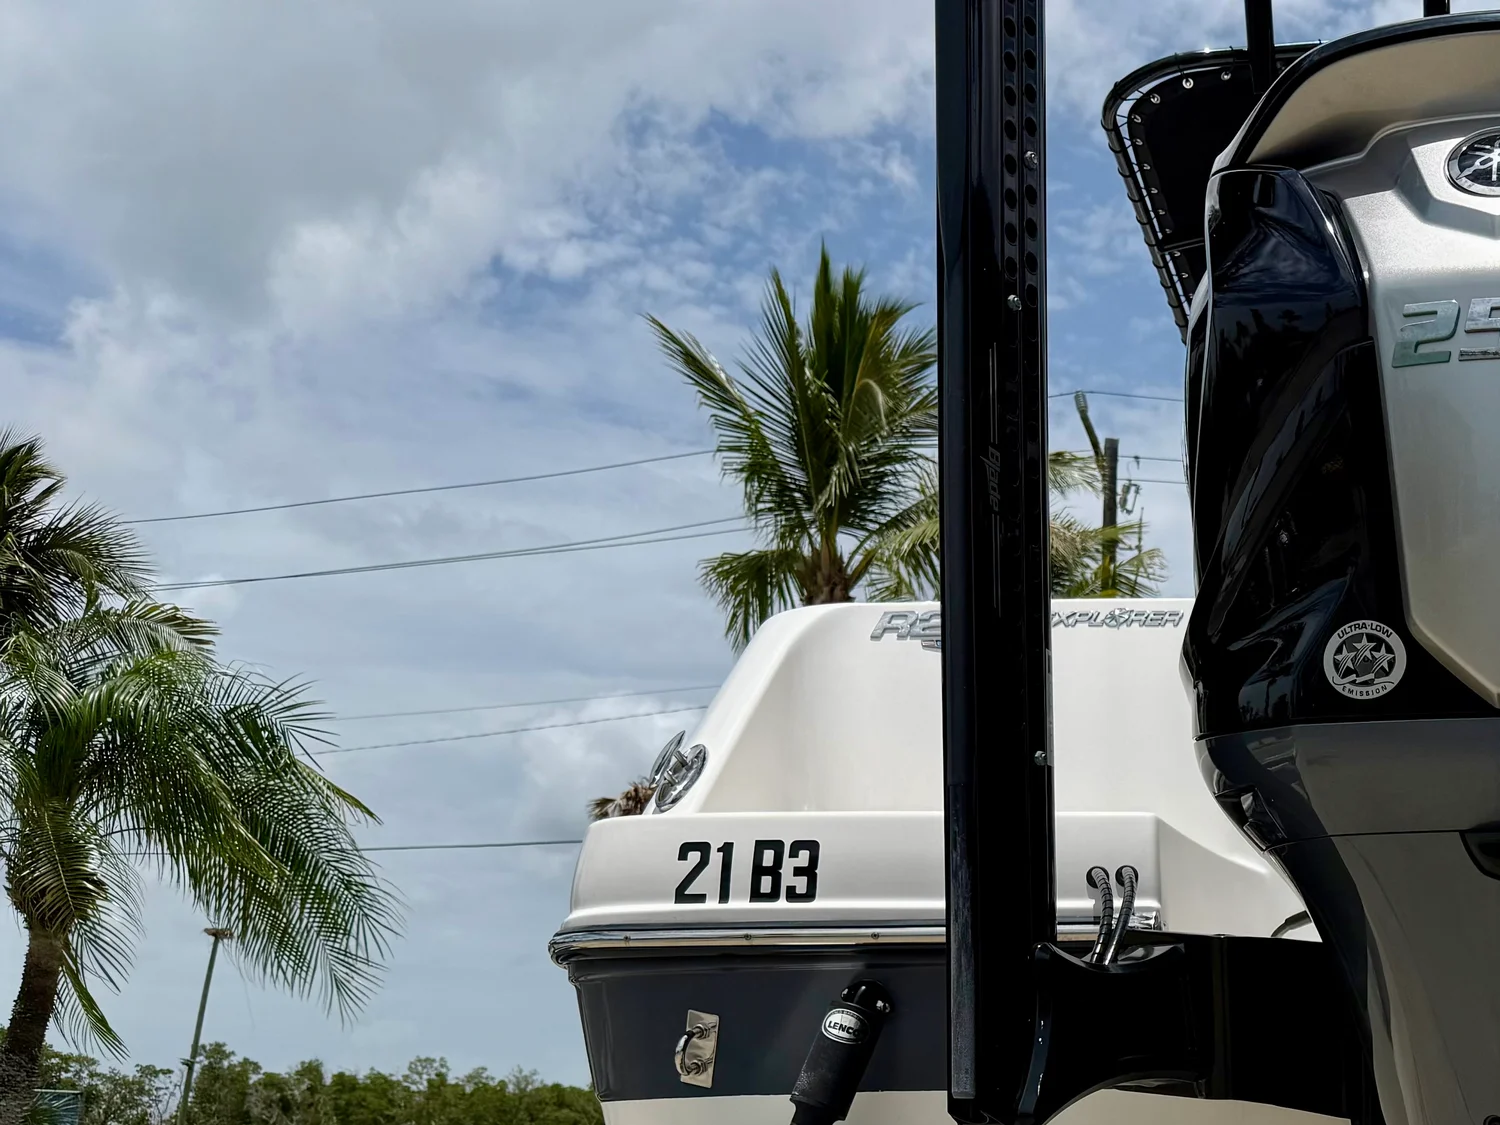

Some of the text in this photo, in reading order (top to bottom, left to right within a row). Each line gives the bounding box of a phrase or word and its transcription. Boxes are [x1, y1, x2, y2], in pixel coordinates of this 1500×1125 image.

[979, 445, 1001, 513] Blade
[1051, 607, 1184, 630] XPLORER
[1341, 684, 1387, 697] EMISSION
[674, 839, 821, 905] 21 B3
